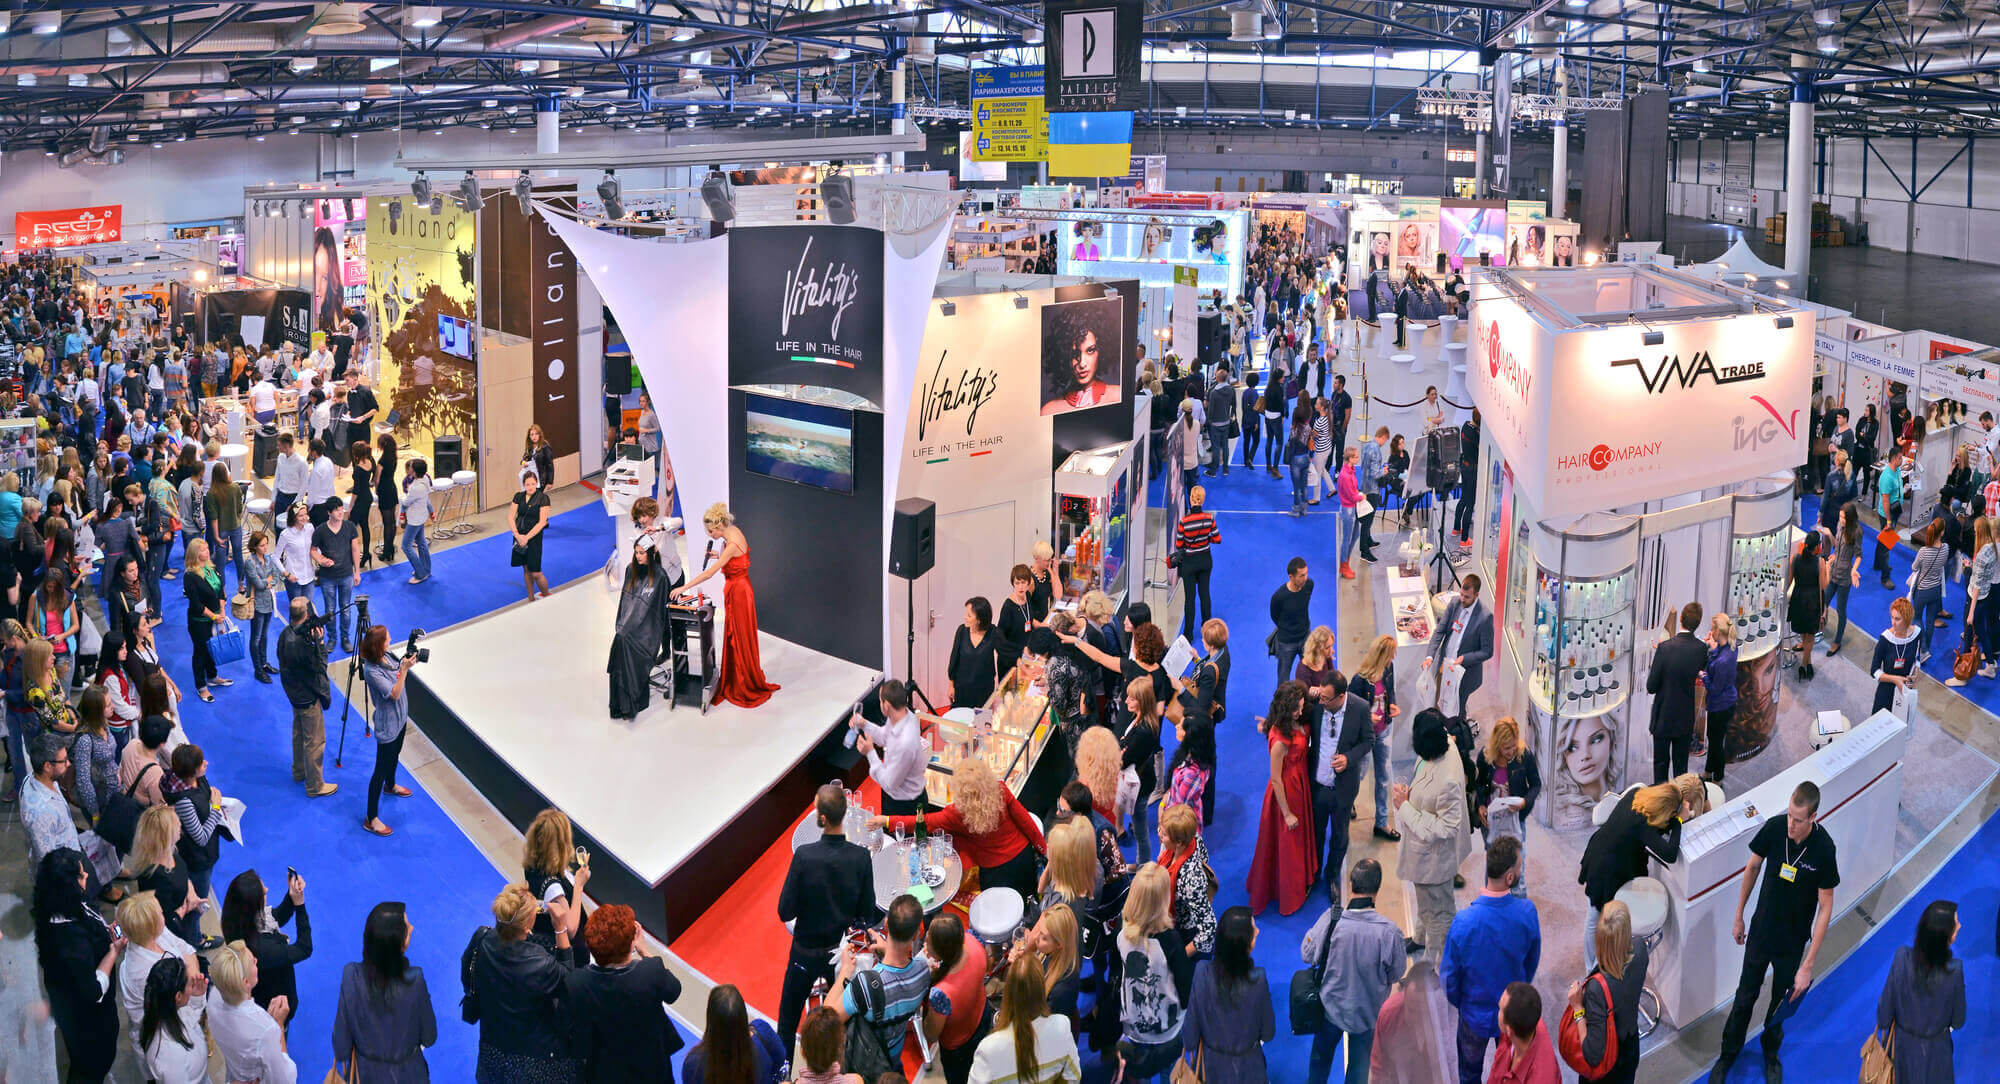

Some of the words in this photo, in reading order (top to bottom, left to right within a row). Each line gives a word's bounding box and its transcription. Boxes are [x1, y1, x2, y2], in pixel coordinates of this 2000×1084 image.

[34, 218, 104, 235] REED
[782, 235, 858, 341] Vitality's
[776, 341, 800, 352] LIFE
[806, 342, 816, 352] IN
[822, 343, 841, 355] THE
[844, 347, 862, 361] HAIR
[1821, 341, 1835, 352] ITALY
[1720, 362, 1764, 378] TRADE
[1850, 351, 1881, 367] CHERCHER
[1883, 361, 1892, 370] LA
[1893, 364, 1916, 378] FEMME
[918, 349, 998, 442] Vitality's
[912, 447, 934, 458] LIFE
[940, 445, 950, 454] IN
[956, 440, 975, 451] THE
[980, 435, 1003, 447] HAIR
